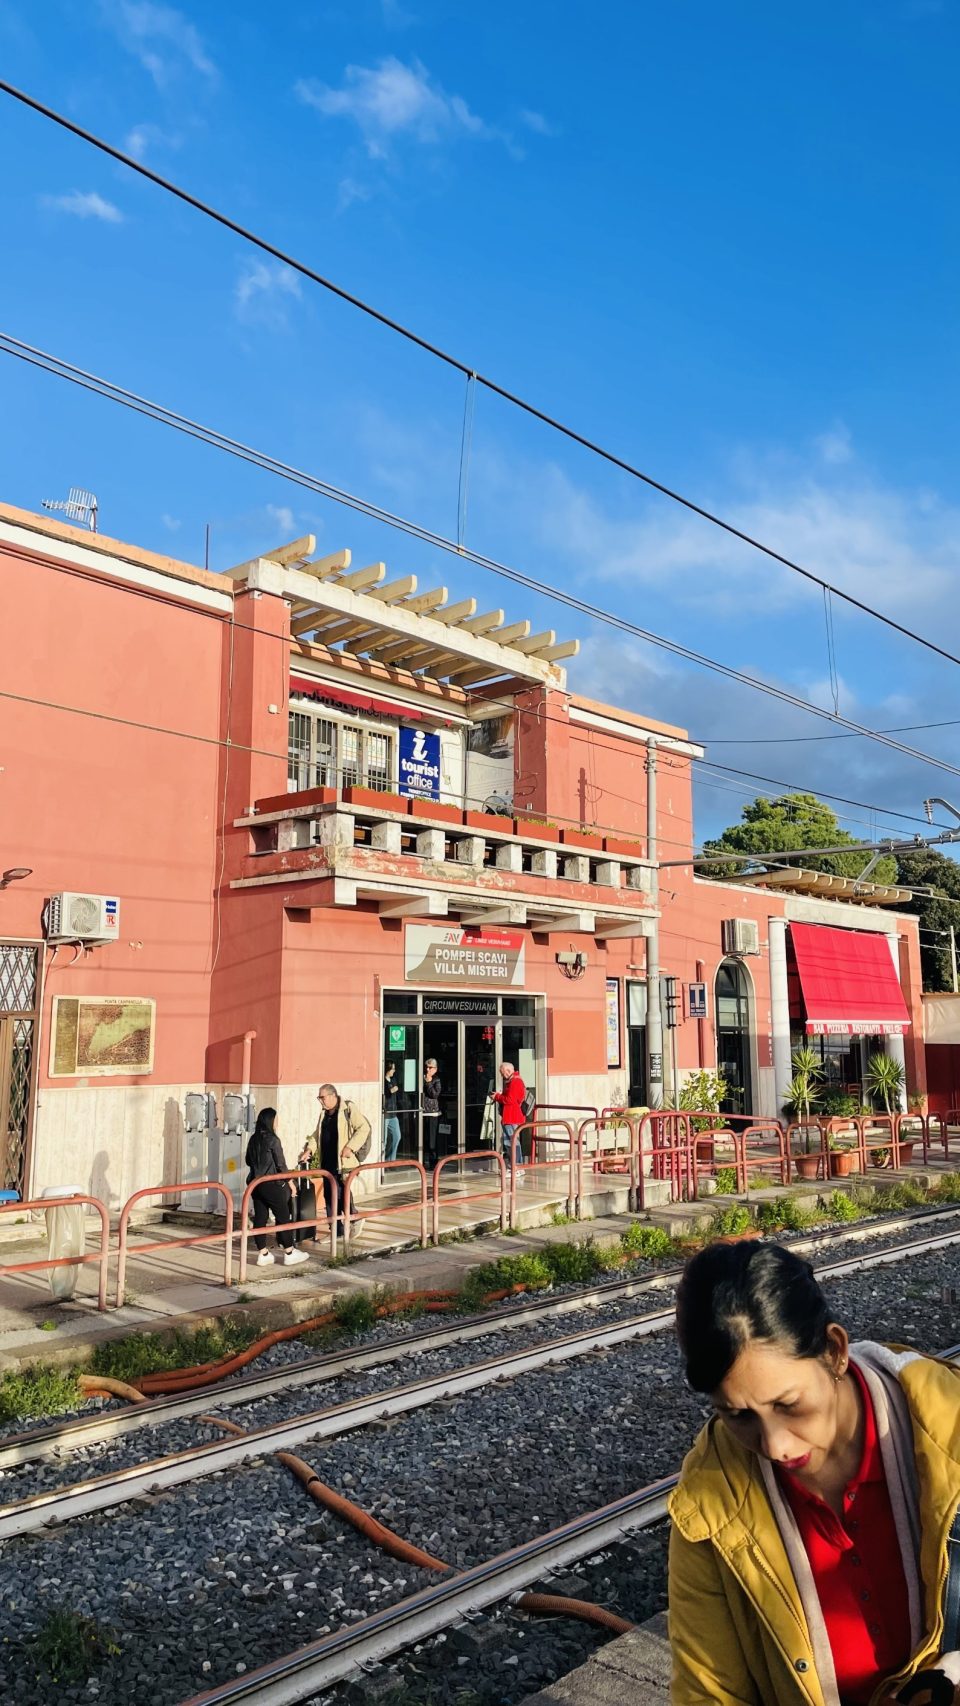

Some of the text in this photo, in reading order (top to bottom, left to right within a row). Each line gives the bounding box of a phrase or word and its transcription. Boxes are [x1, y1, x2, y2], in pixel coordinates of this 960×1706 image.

[402, 758, 438, 778] tourist
[407, 774, 433, 789] office
[435, 948, 507, 964] POMPEI SCAVI
[434, 962, 508, 978] VILLA MISTERI
[424, 1000, 497, 1012] CIRCUMVESUVIANA
